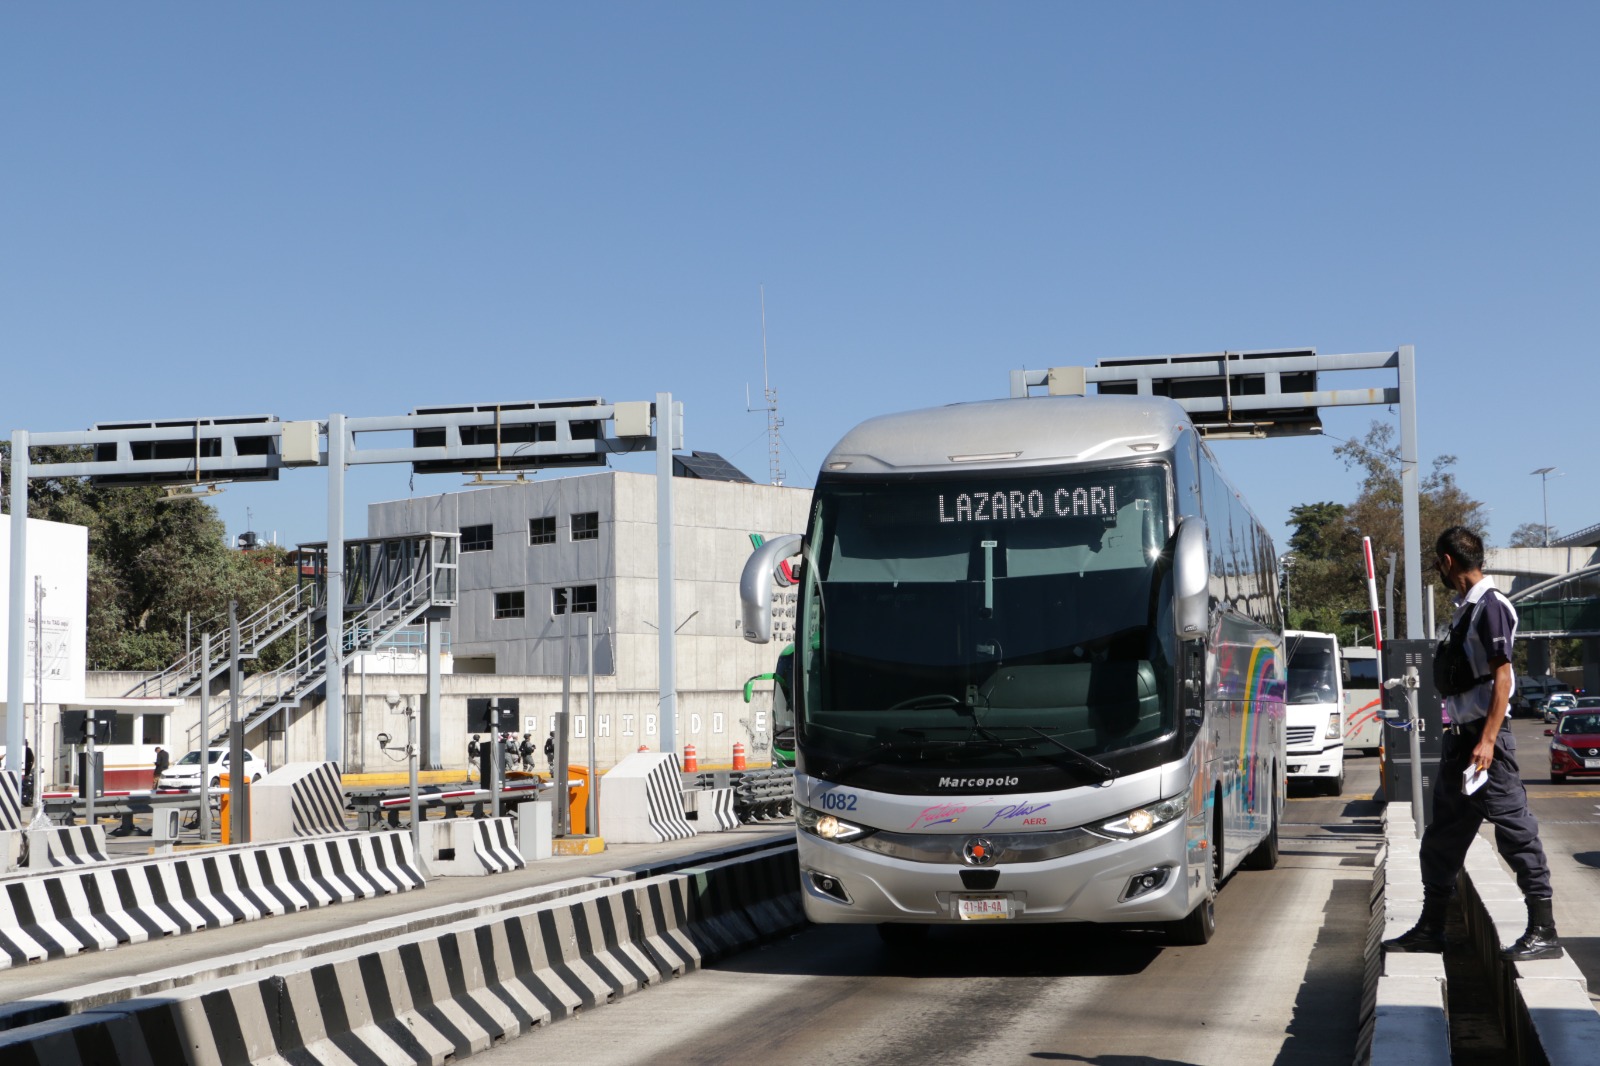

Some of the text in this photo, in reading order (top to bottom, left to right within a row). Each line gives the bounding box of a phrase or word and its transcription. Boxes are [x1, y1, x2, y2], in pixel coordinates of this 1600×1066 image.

[939, 486, 1115, 523] LAZARO CARI
[938, 776, 1019, 788] Marcopolo
[819, 793, 858, 811] 1082
[982, 801, 1051, 830] Plus
